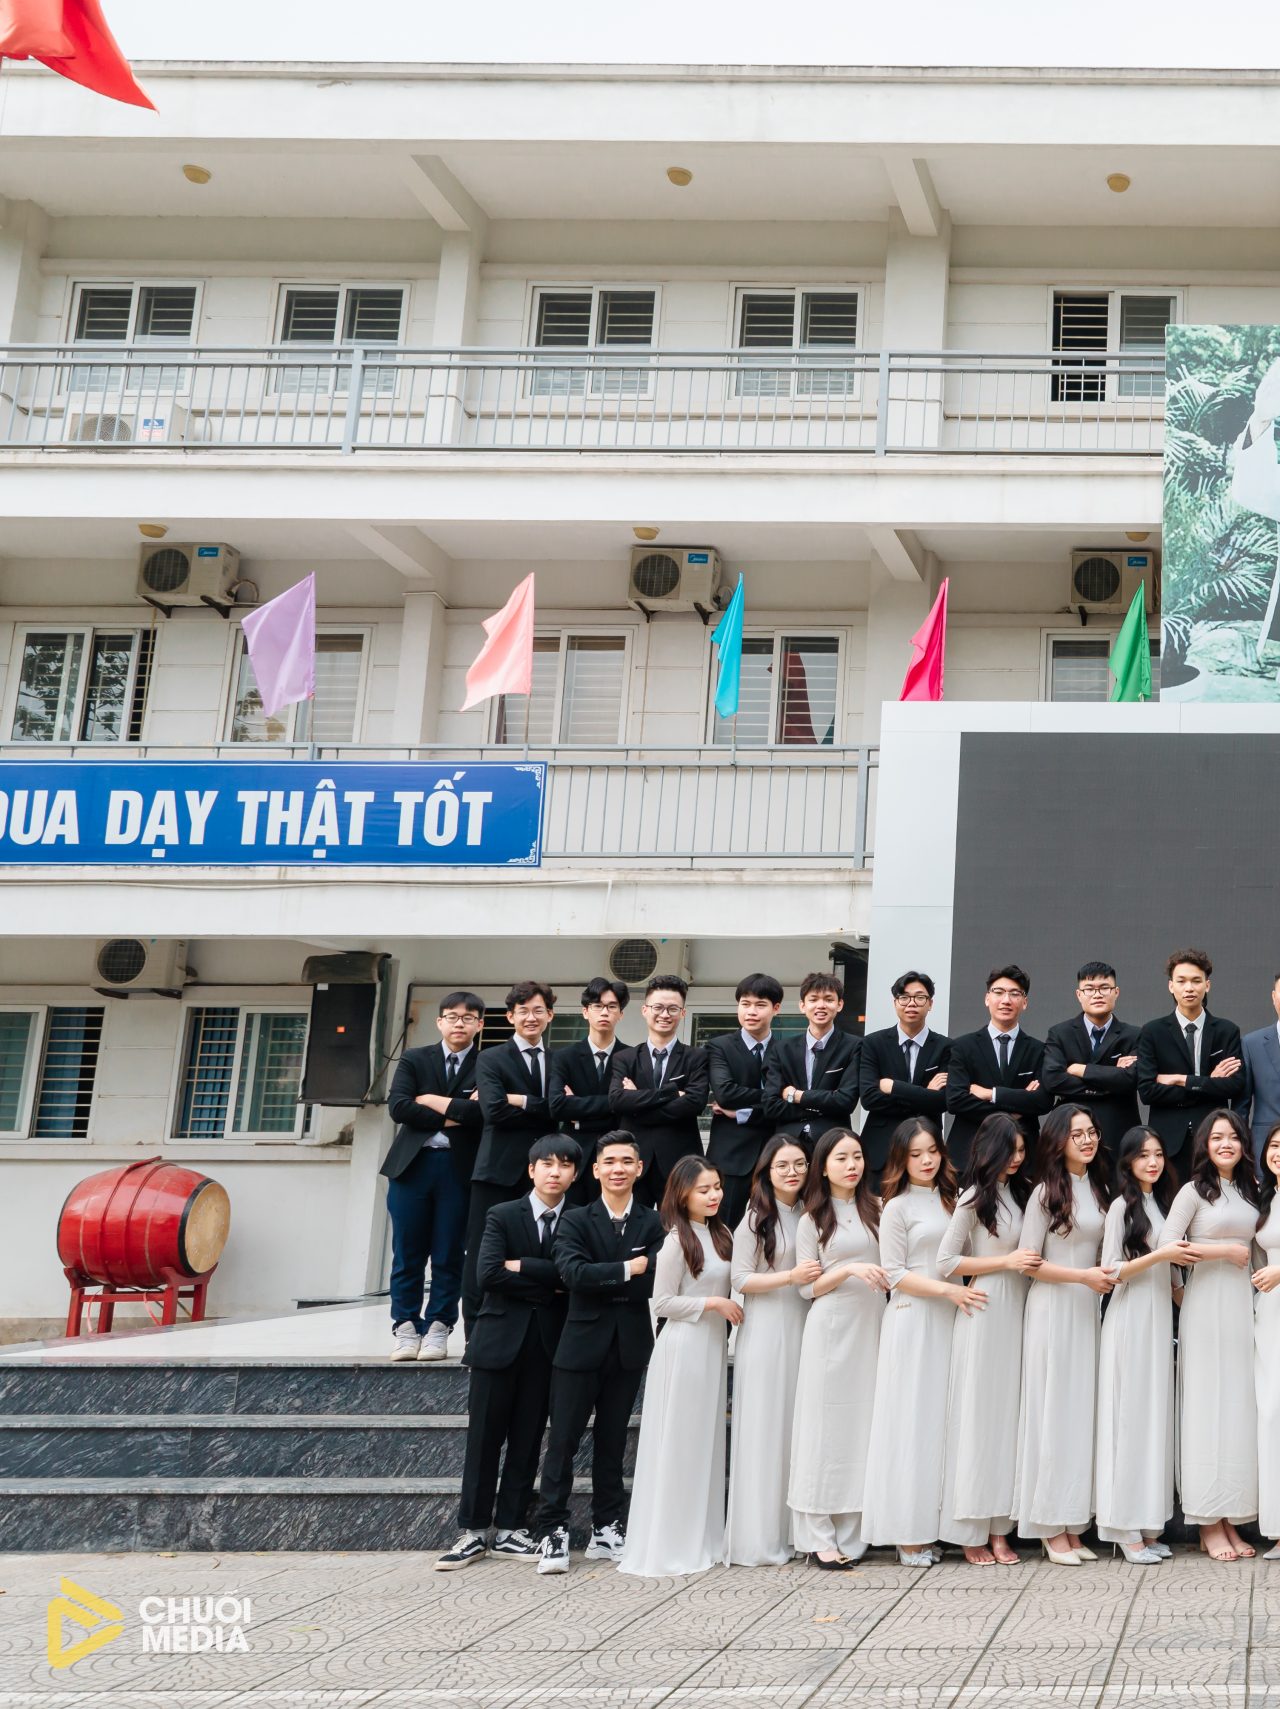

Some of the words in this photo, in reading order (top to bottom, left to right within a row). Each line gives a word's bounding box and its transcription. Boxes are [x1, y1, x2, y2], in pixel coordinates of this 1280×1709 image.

[0, 790, 79, 845] UA
[104, 790, 219, 858] DẠY
[237, 778, 375, 859] THẬT
[393, 771, 493, 847] TỐT
